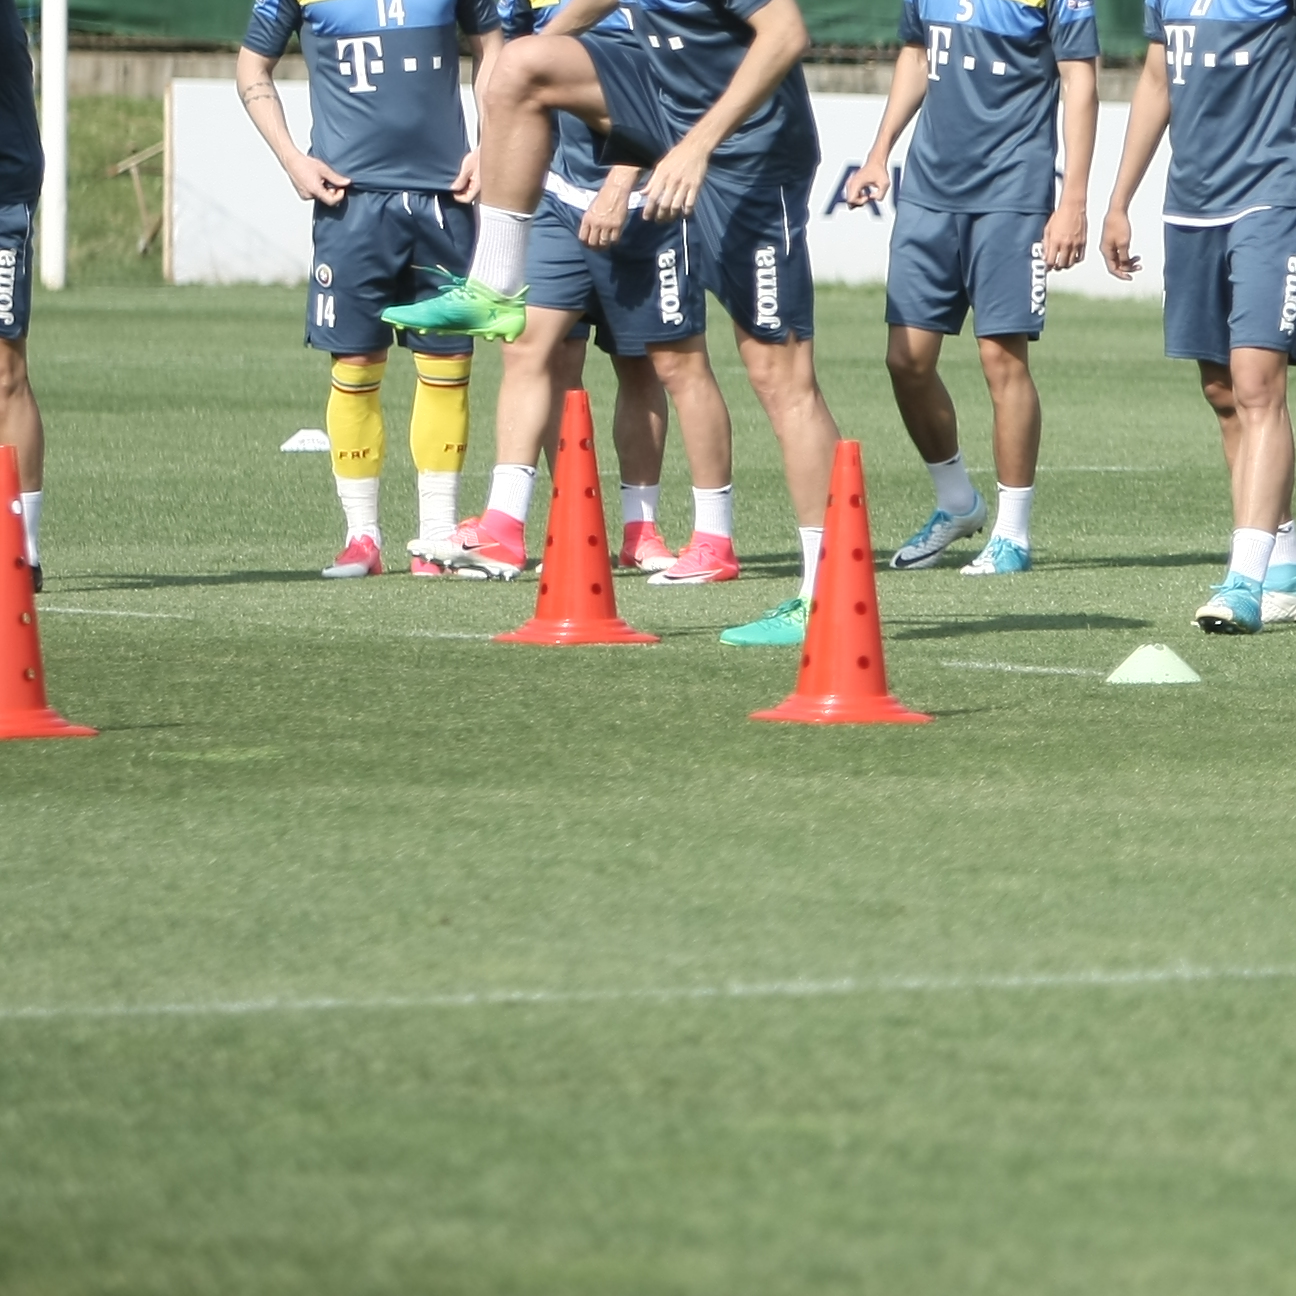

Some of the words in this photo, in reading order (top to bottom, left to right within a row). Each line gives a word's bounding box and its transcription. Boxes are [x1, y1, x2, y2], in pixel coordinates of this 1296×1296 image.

[315, 293, 336, 328] 14
[657, 248, 685, 326] Joma
[755, 246, 782, 331] Joma
